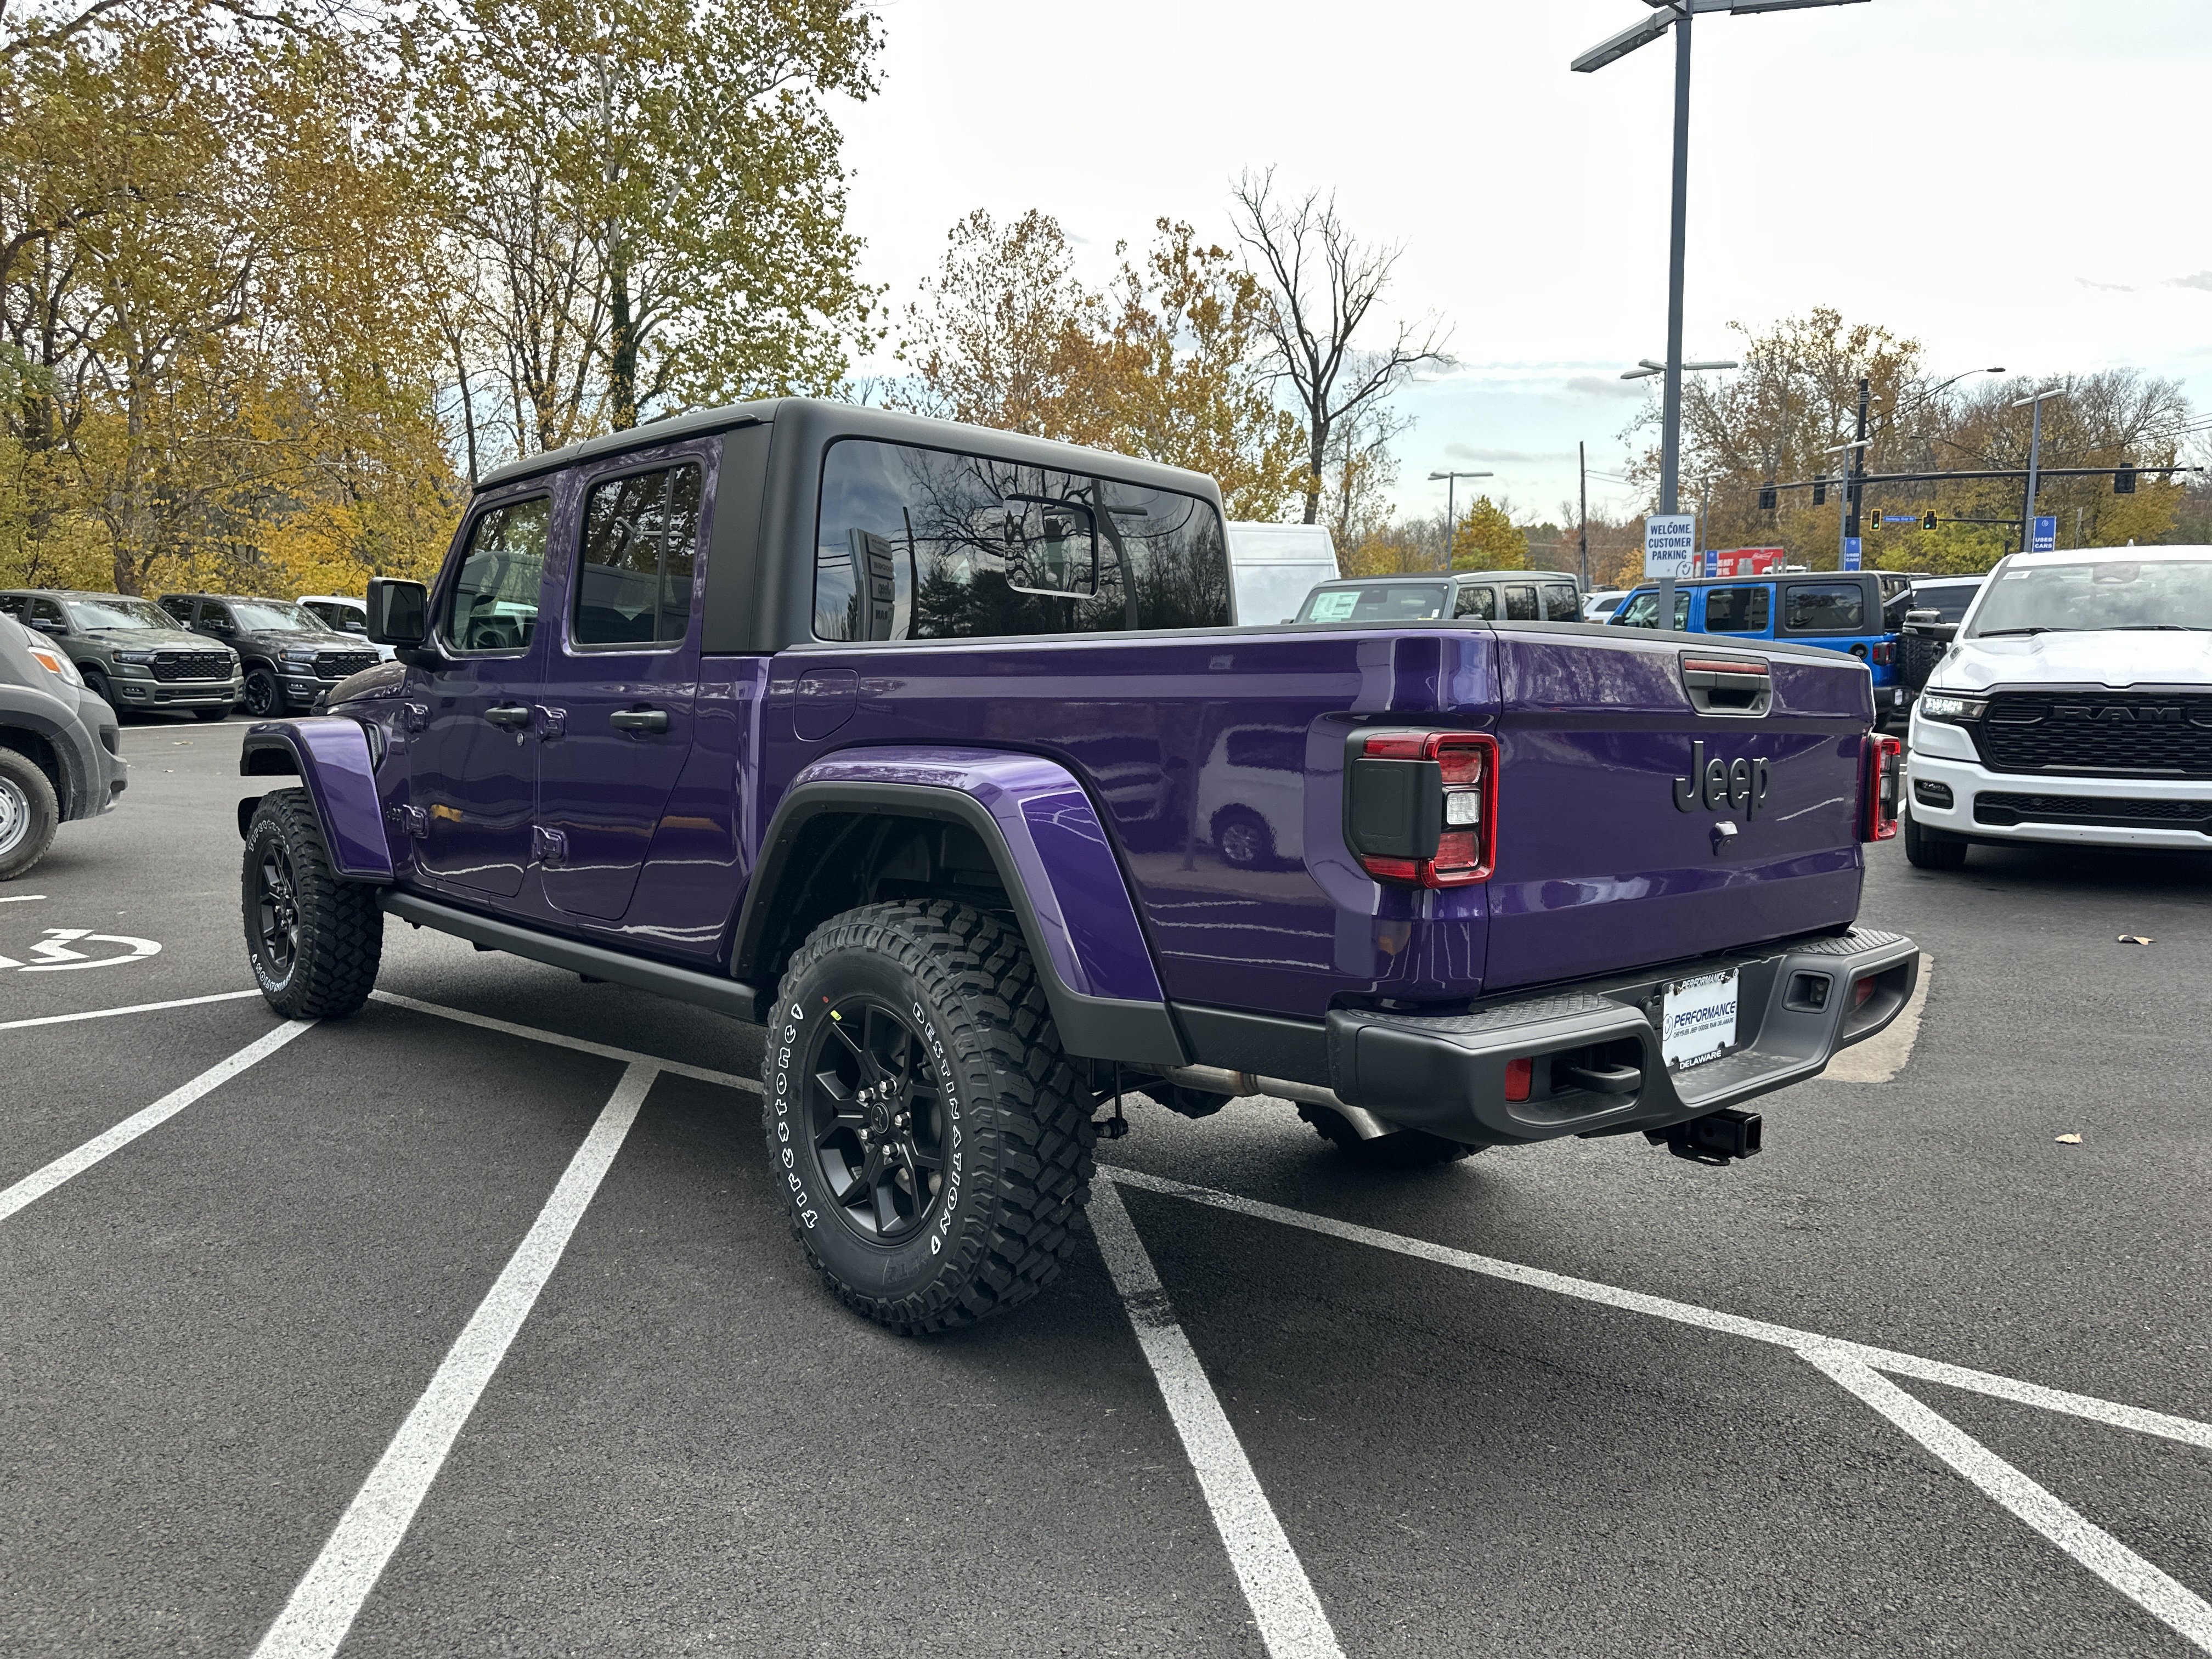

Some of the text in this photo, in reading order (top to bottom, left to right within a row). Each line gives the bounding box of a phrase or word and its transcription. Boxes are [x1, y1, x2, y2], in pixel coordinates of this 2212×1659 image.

[1650, 524, 1690, 534] WELCOME
[1648, 537, 1691, 548] CUSTOMER
[1652, 550, 1687, 561] PARKING
[2053, 706, 2182, 721] RAM
[1672, 740, 1771, 822] Jeep
[1681, 972, 1726, 989] PERFORMANCE
[1674, 1001, 1736, 1028] PERFORMANCE
[1673, 1028, 1689, 1039] CHRYSLER
[1699, 1024, 1709, 1032] DODGE
[1717, 1017, 1734, 1026] DELAWARE
[1679, 1049, 1722, 1070] DELAWARE
[775, 1025, 819, 1229] Firestone
[913, 1002, 963, 1236] DESTINATION
